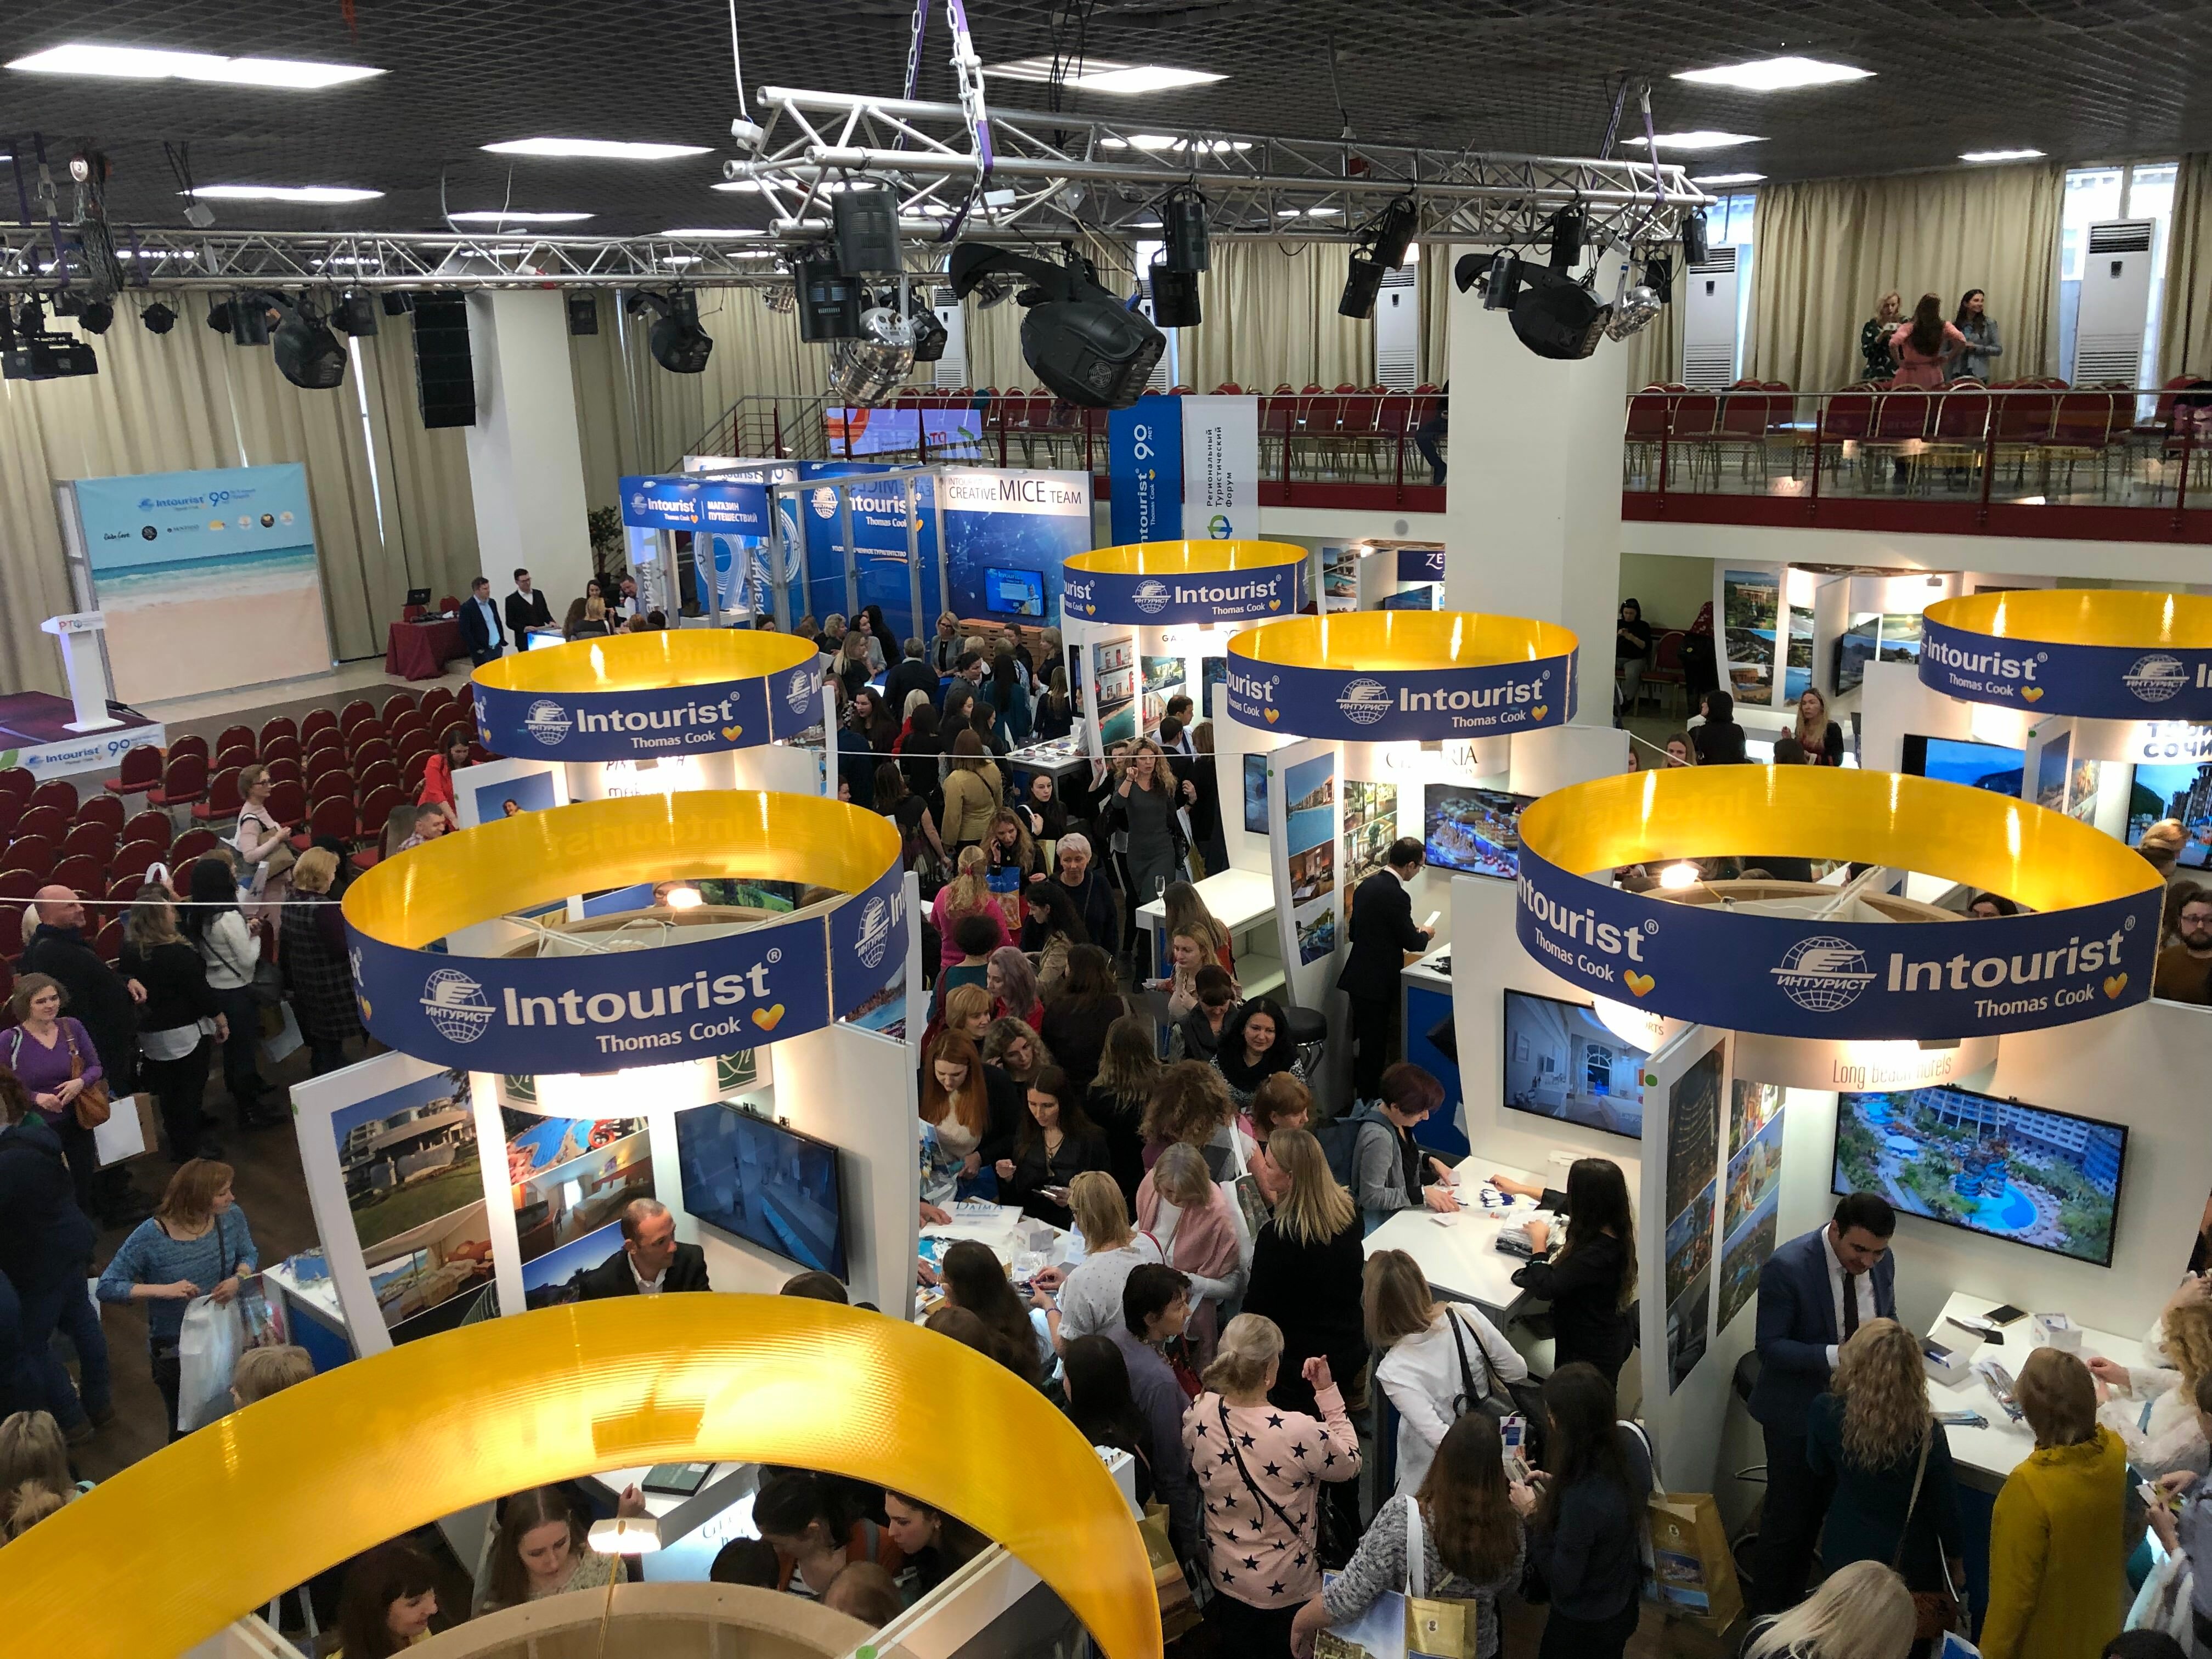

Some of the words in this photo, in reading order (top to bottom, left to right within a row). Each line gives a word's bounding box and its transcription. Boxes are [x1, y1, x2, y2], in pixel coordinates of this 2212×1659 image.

[1133, 424, 1155, 460] 90
[949, 487, 997, 500] CREATIVE
[1000, 479, 1046, 503] MICE
[1049, 490, 1081, 504] TEAM
[707, 500, 739, 511] МАГАЗИН
[708, 511, 758, 523] ПУТЕШЕСТВИЙ
[866, 516, 891, 526] Thomas
[1212, 605, 1244, 615] Thomas
[1246, 603, 1266, 613] Cook
[1949, 672, 1983, 691] Thomas
[1986, 681, 2014, 697] Cook
[1244, 703, 1260, 717] Cook
[1452, 714, 1497, 729] Thomas
[1500, 709, 1526, 723] Cook
[528, 724, 570, 732] ИНТУРИСТ
[631, 735, 681, 749] Thomas
[685, 730, 716, 744] Cook
[46, 748, 100, 763] Intourist
[108, 739, 131, 757] 90
[1535, 927, 1573, 966] Thomas
[1578, 955, 1615, 983] Cook
[1776, 975, 1871, 991] ИНТУРИСТ
[1974, 997, 2048, 1019] Thomas
[2054, 984, 2095, 1007] Cook
[425, 1005, 493, 1023] ИНТУРИСТ
[596, 1029, 682, 1054] Thomas
[689, 1016, 741, 1042] Cook
[1833, 1059, 1866, 1090] Long
